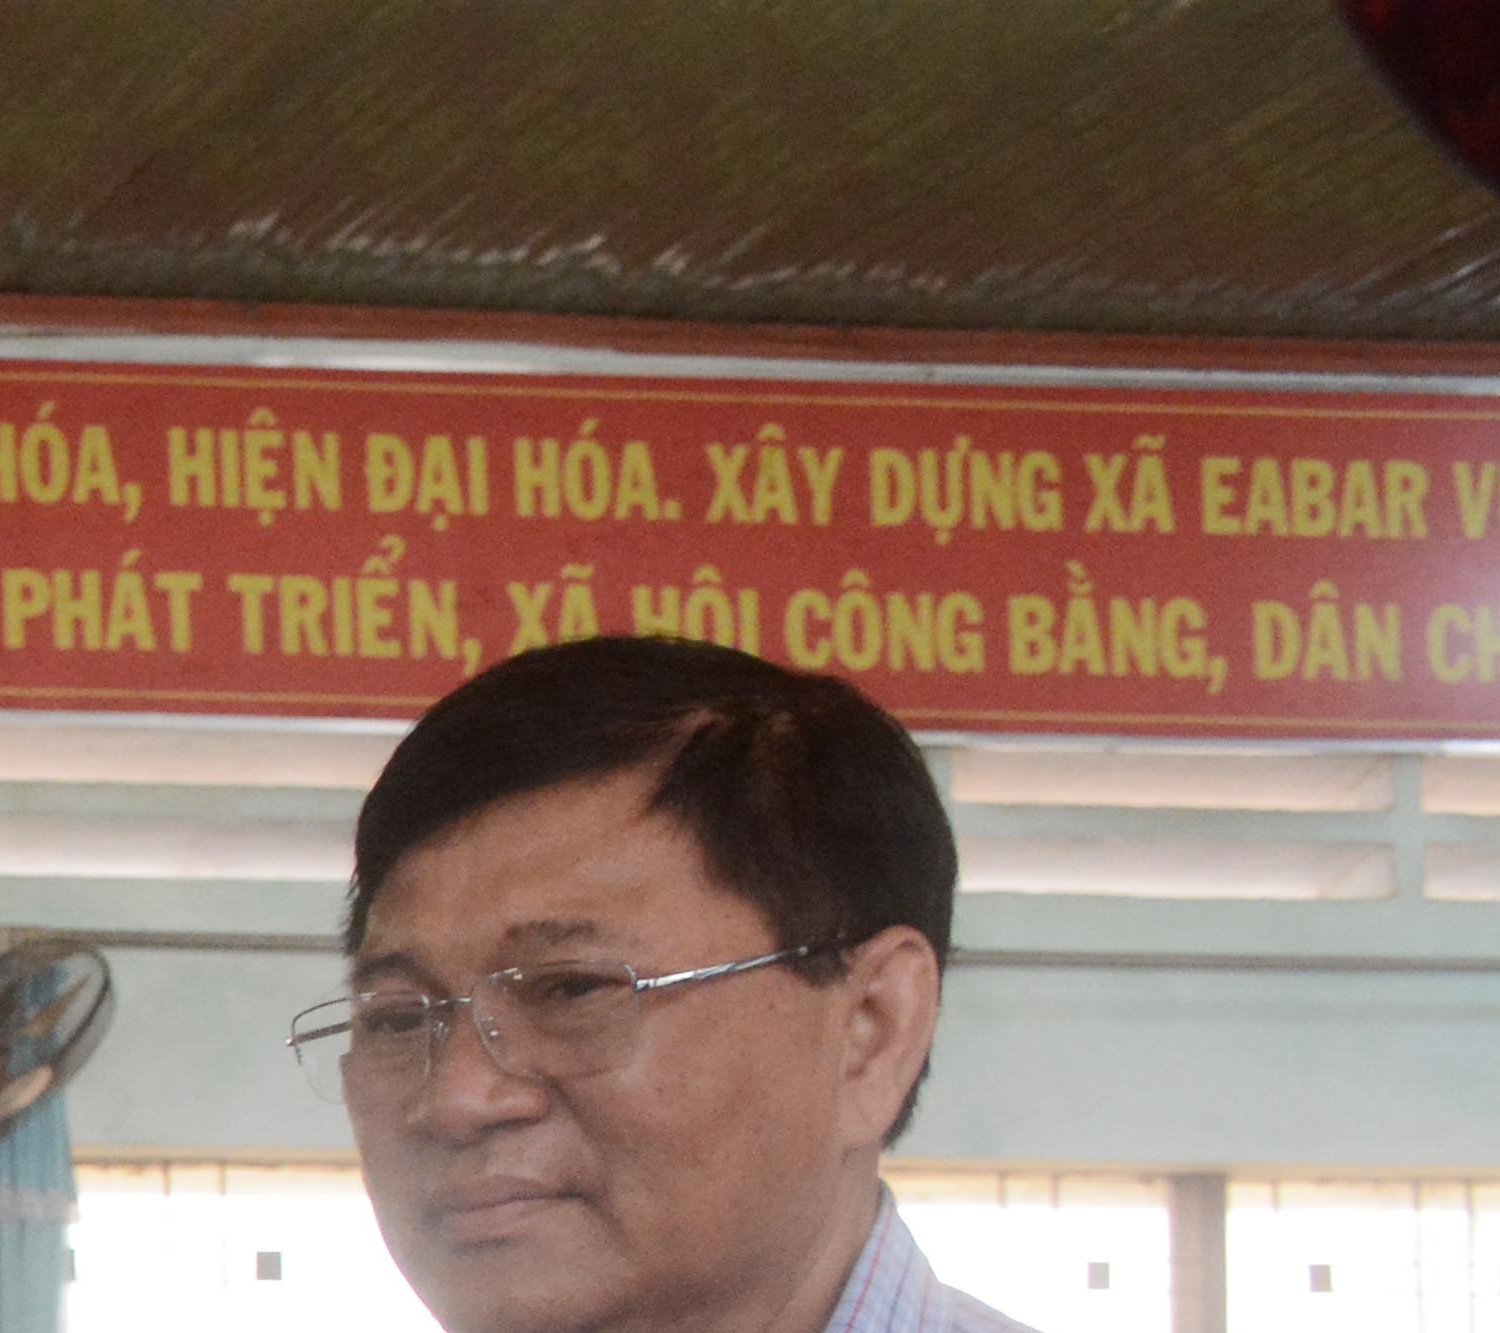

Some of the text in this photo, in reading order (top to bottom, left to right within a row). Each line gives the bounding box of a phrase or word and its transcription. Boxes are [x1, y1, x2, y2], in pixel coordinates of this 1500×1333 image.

[165, 407, 344, 526] HIỆN
[362, 431, 491, 534] ĐẠI
[512, 417, 683, 522] HÓA.
[704, 422, 845, 527] XÂY
[868, 434, 1064, 547] DỰNG
[1083, 433, 1177, 535] XÃ
[1199, 455, 1430, 540] EABAR
[1452, 462, 1500, 539] V
[0, 548, 205, 655] PHÁT
[224, 533, 484, 678] TRIỂN,
[505, 562, 601, 657] XÃ
[782, 568, 987, 676] CÔNG
[1006, 559, 1229, 695] BẰNG,
[1250, 579, 1401, 682] DÂN
